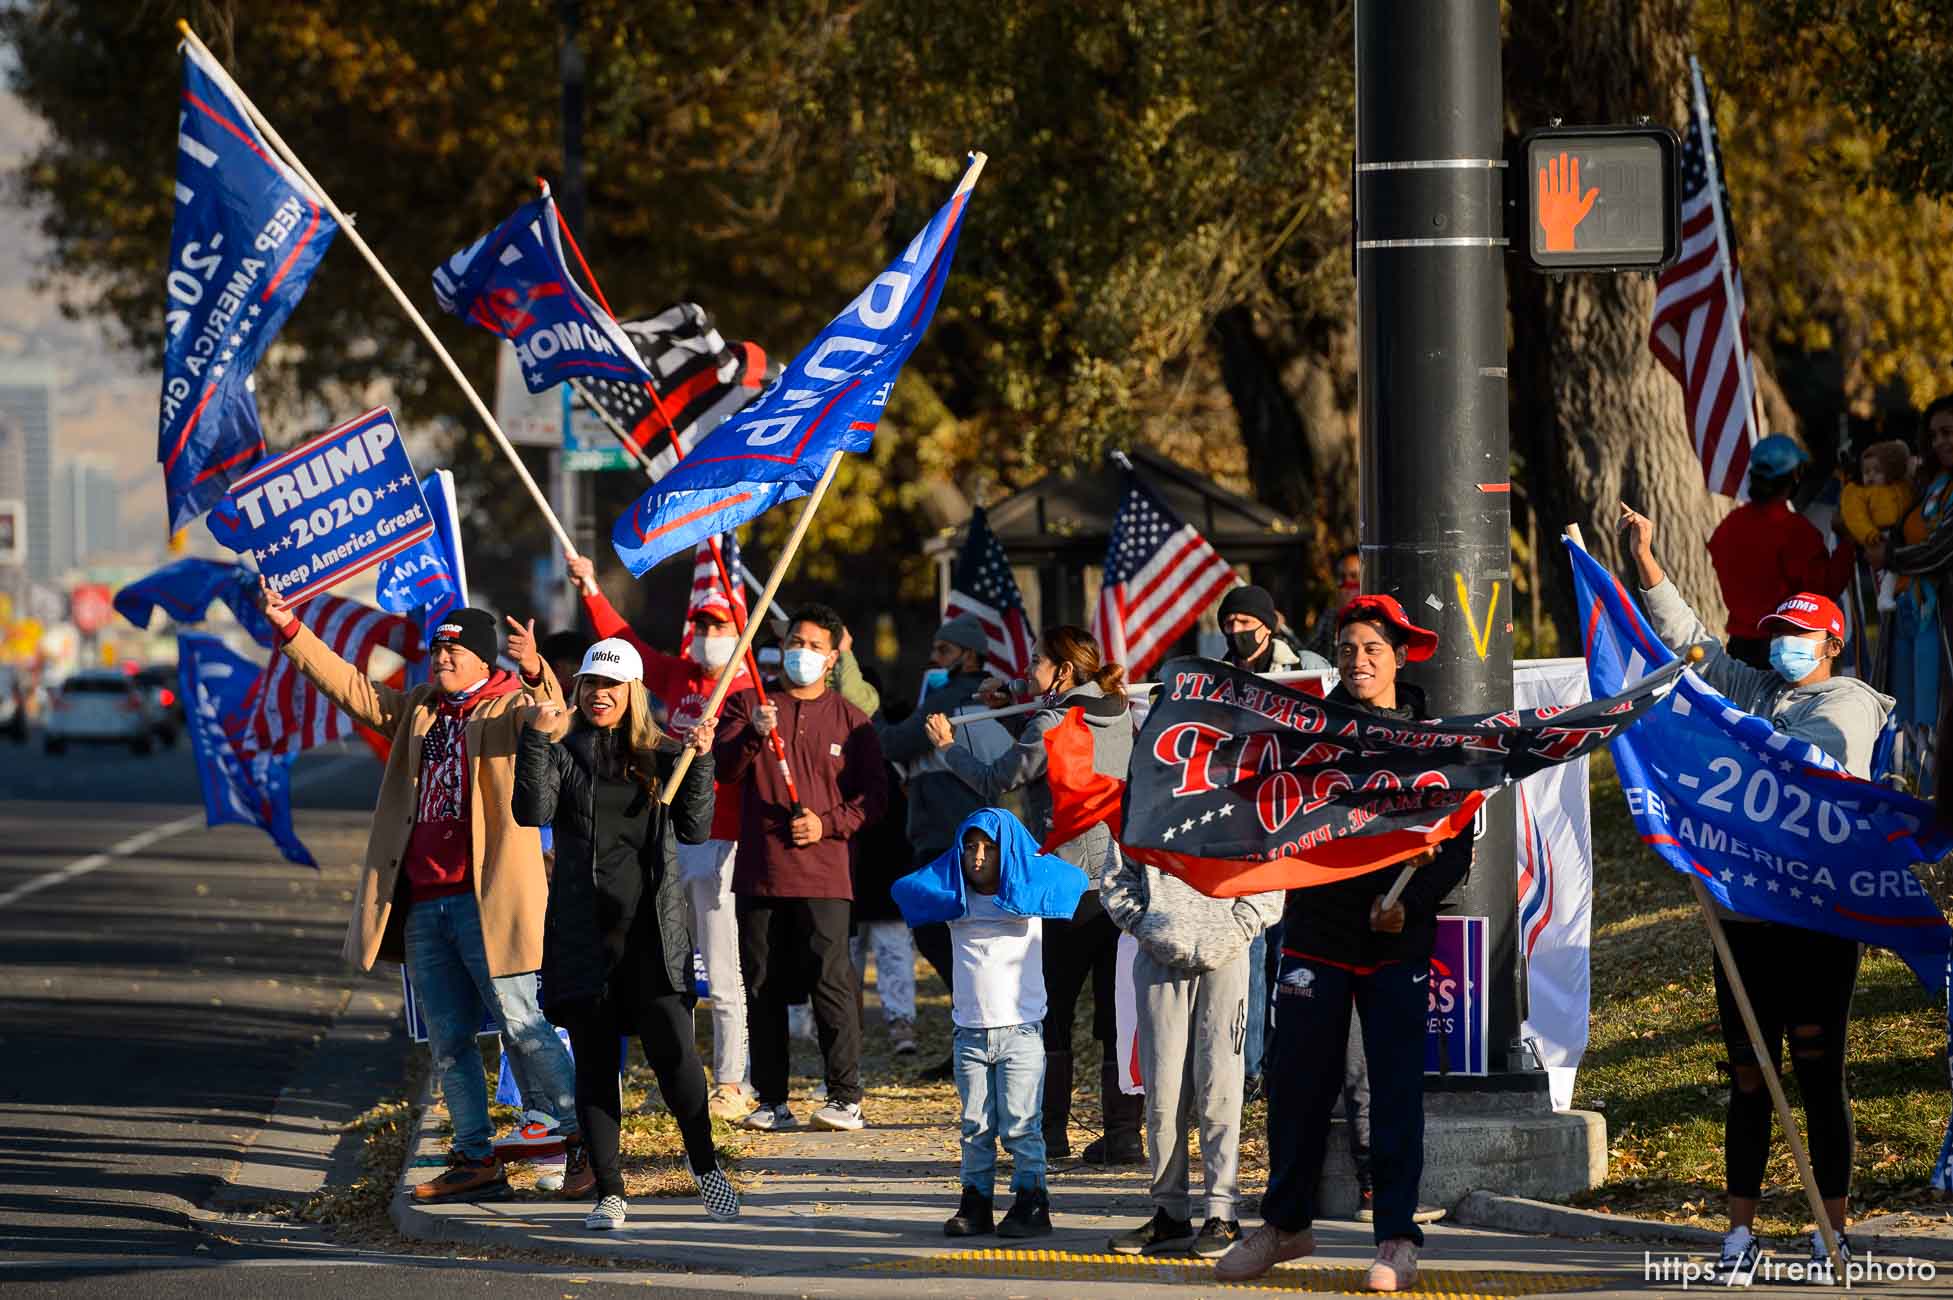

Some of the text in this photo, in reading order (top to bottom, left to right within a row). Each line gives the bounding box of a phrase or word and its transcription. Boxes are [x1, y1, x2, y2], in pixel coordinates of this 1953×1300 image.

[235, 422, 396, 529] TRUMP
[267, 502, 425, 595] Keep America Great
[289, 487, 374, 550] 2020
[591, 650, 621, 664] Woke
[1678, 814, 1838, 892] AMERICA
[1849, 868, 1930, 898] GRE
